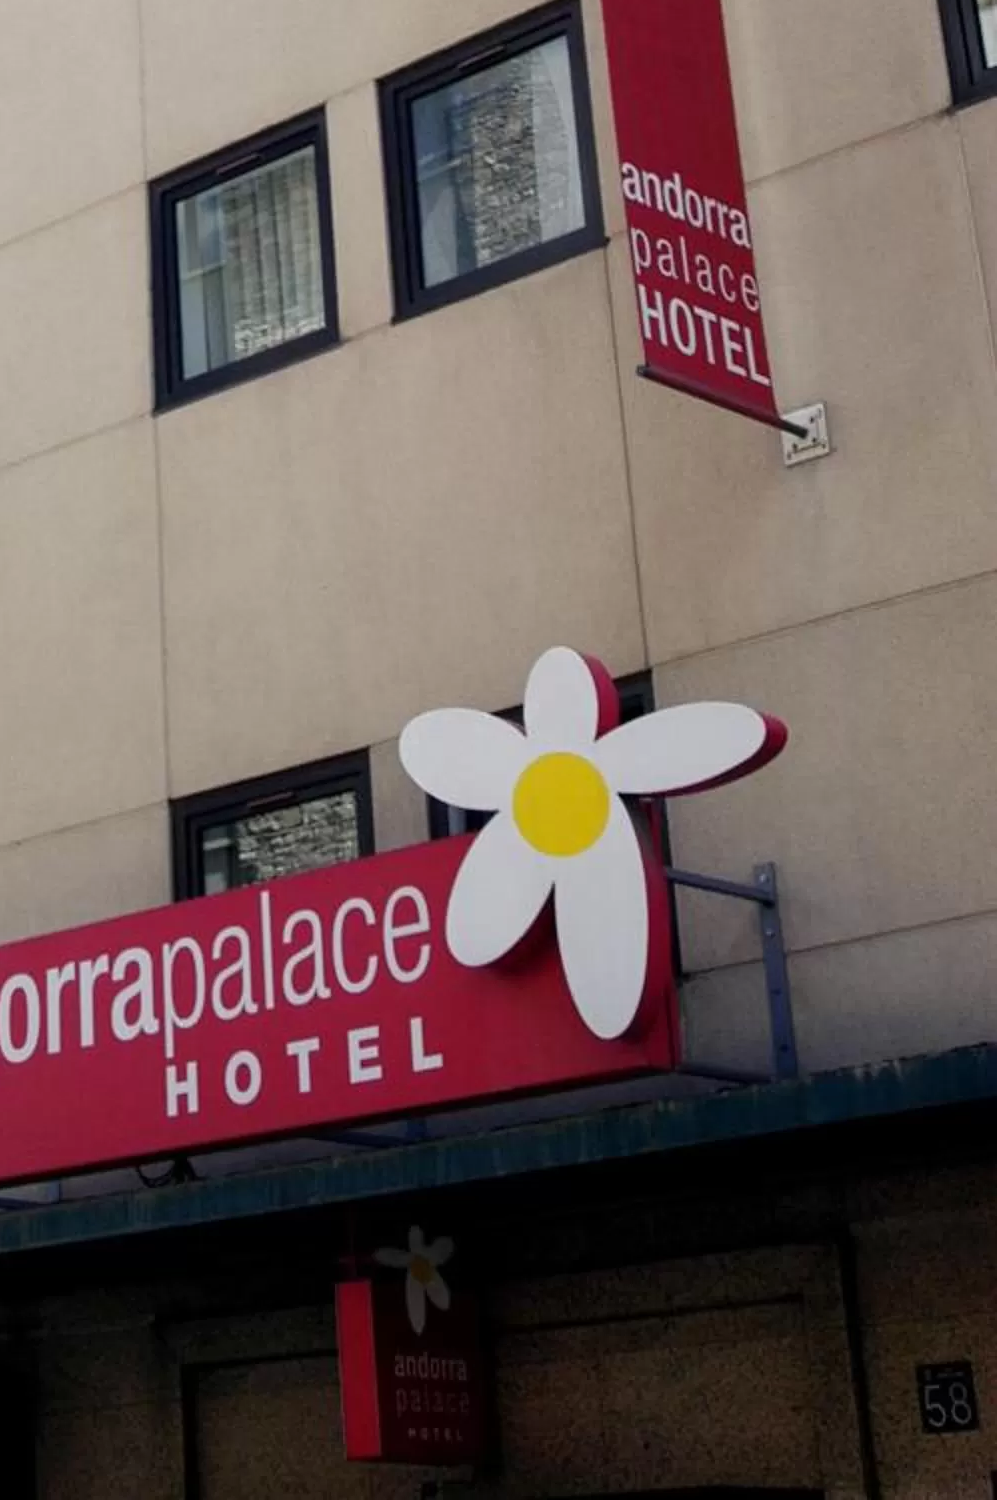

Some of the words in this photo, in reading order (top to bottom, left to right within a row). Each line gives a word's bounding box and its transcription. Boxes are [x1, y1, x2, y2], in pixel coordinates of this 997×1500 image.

[621, 162, 751, 248] andorra
[630, 227, 760, 312] palace
[637, 284, 770, 386] HOTEL
[166, 1017, 443, 1117] HOTEL
[394, 1351, 468, 1381] andorra
[395, 1383, 470, 1418] palace
[924, 1382, 972, 1428] 58
